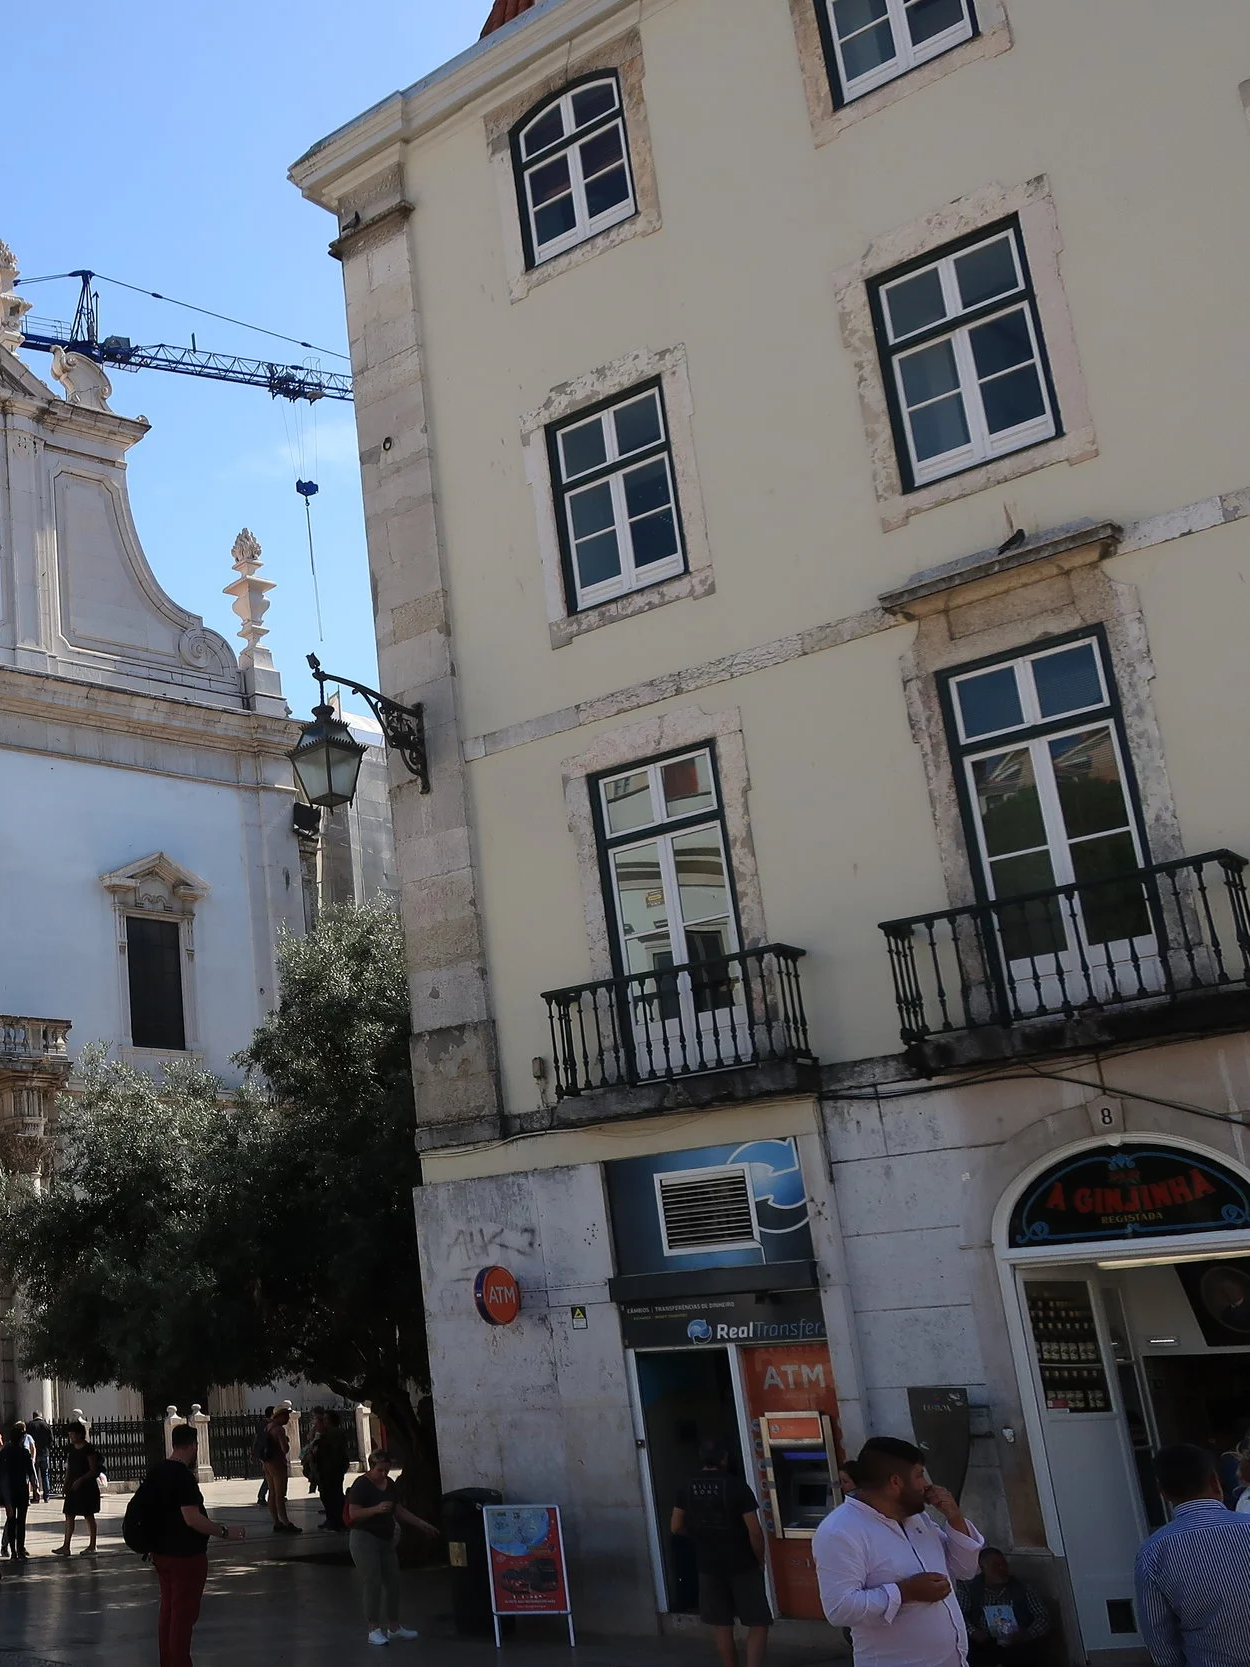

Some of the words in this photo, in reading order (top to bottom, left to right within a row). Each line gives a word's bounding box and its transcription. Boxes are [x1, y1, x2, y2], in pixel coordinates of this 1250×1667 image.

[1101, 1107, 1113, 1125] 8
[1045, 1180, 1067, 1212] A
[1073, 1167, 1218, 1214] GINJINHA
[488, 1285, 516, 1304] ATM
[763, 1363, 826, 1391] ATM
